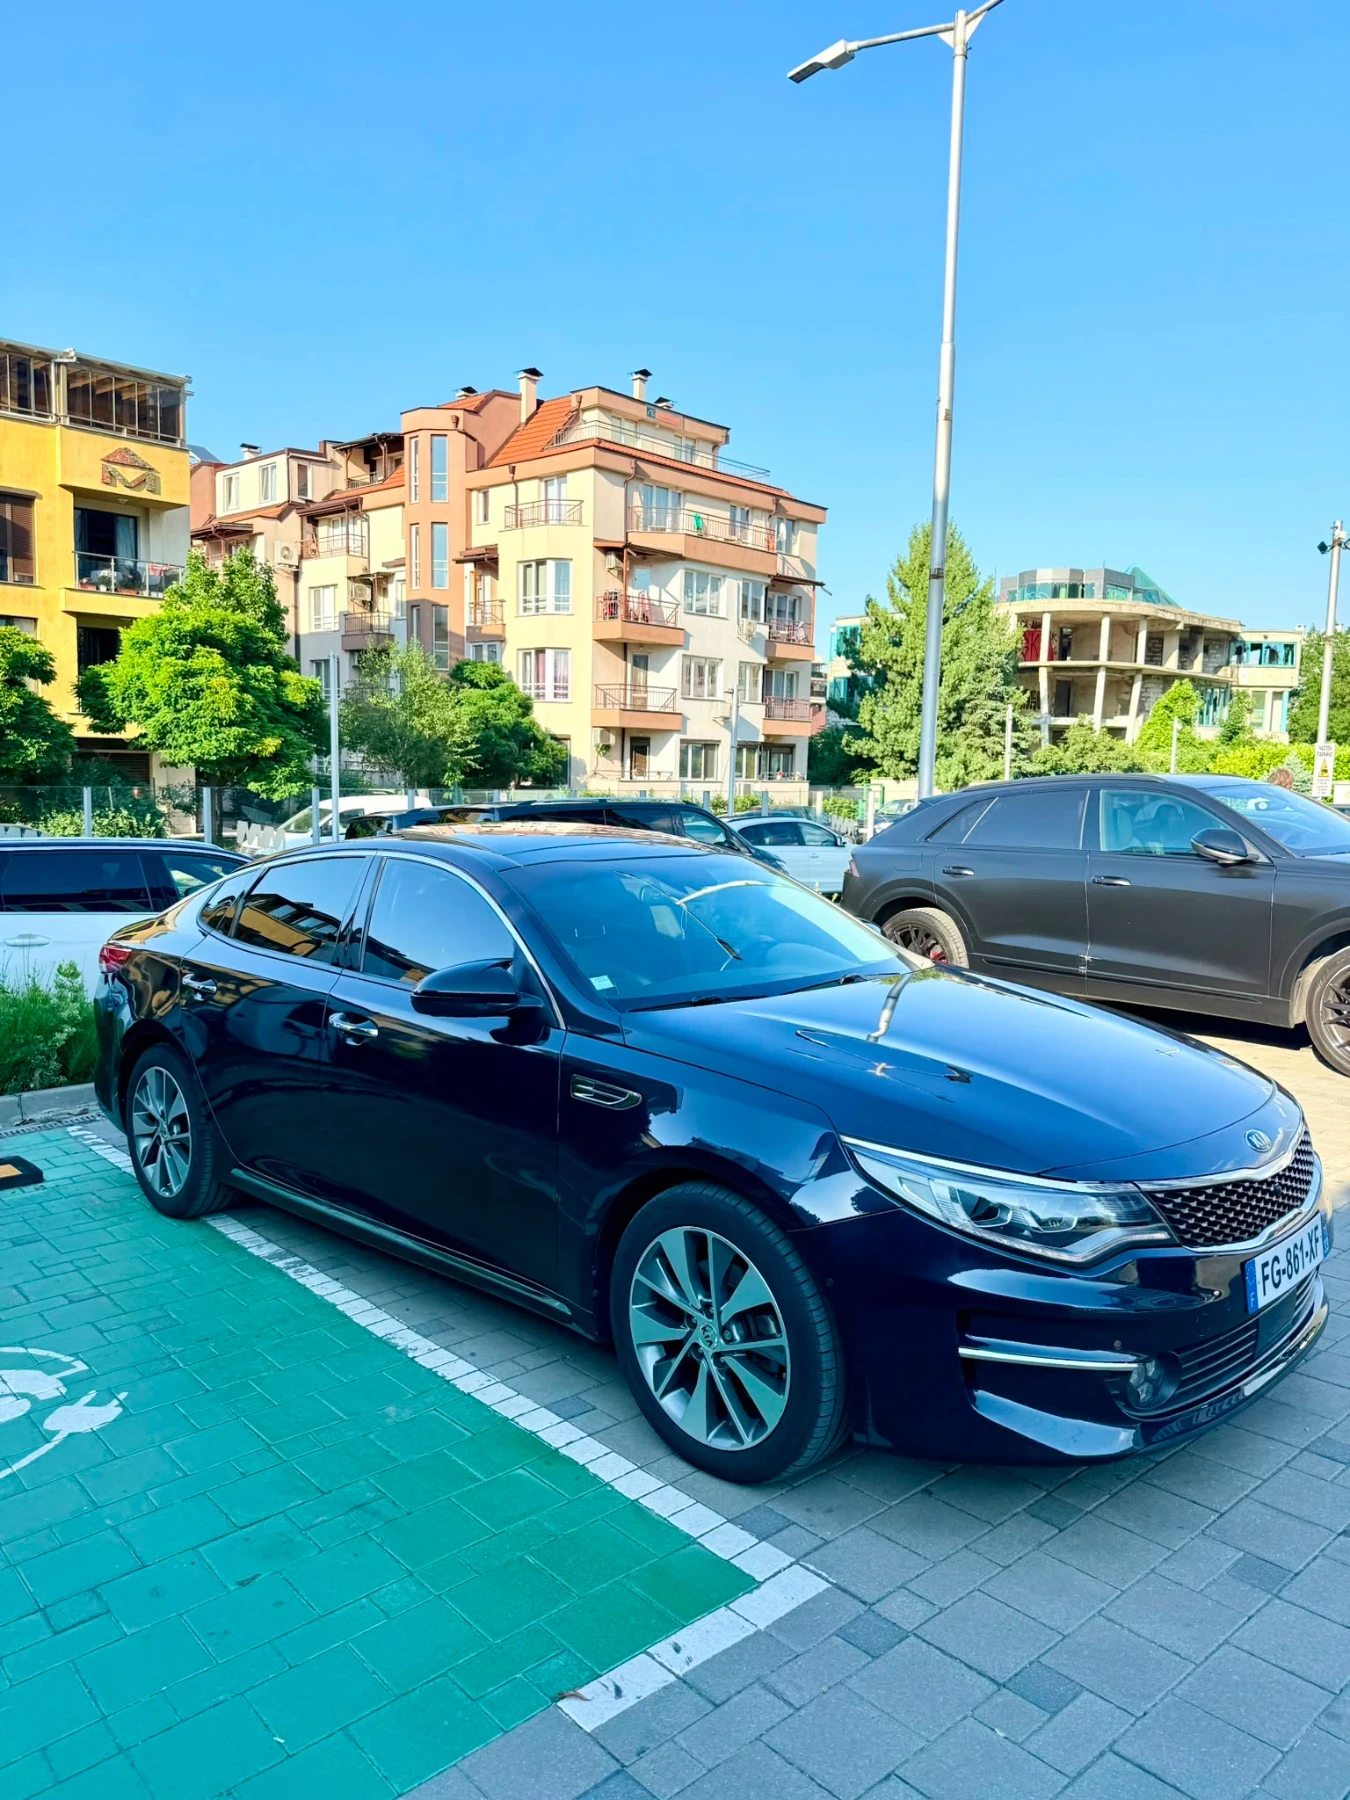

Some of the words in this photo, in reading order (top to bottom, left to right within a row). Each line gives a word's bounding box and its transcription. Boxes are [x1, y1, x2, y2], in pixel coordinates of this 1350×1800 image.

[1261, 1224, 1319, 1297] FG-861-XF
[1250, 1291, 1255, 1308] F
[701, 1325, 713, 1347] KIA
